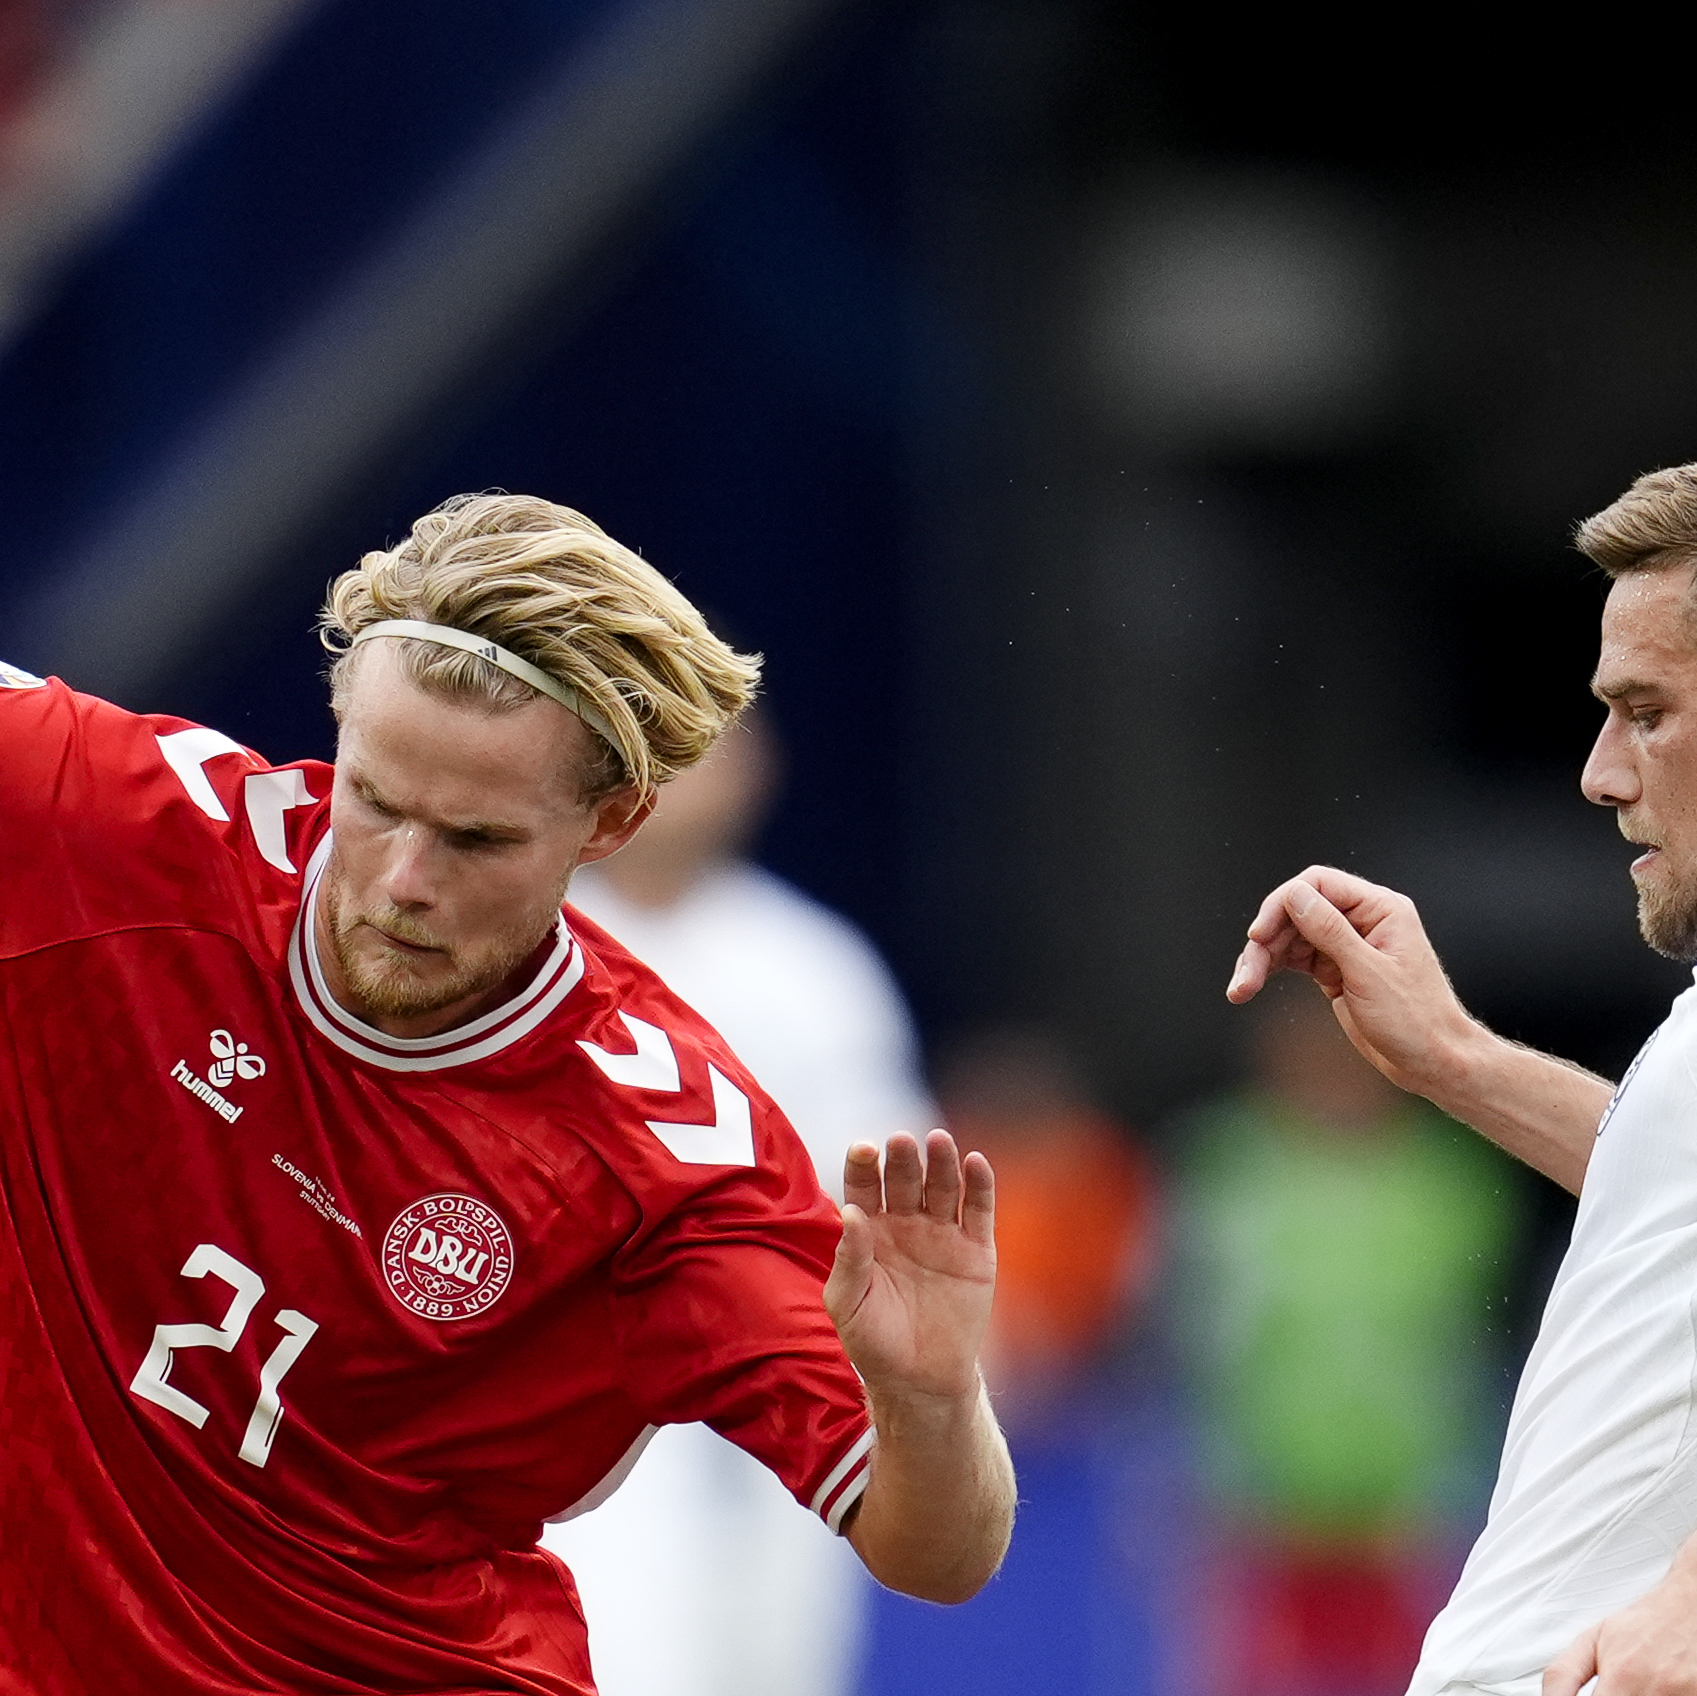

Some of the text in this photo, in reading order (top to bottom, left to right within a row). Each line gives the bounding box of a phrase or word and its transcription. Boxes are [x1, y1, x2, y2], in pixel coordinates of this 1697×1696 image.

[170, 1059, 244, 1124] hummel
[271, 1153, 316, 1194] SLOVENIA
[387, 1211, 420, 1286] DANSK
[408, 1227, 489, 1285] DBU
[403, 1289, 453, 1317] 1889
[130, 1244, 319, 1468] 21
